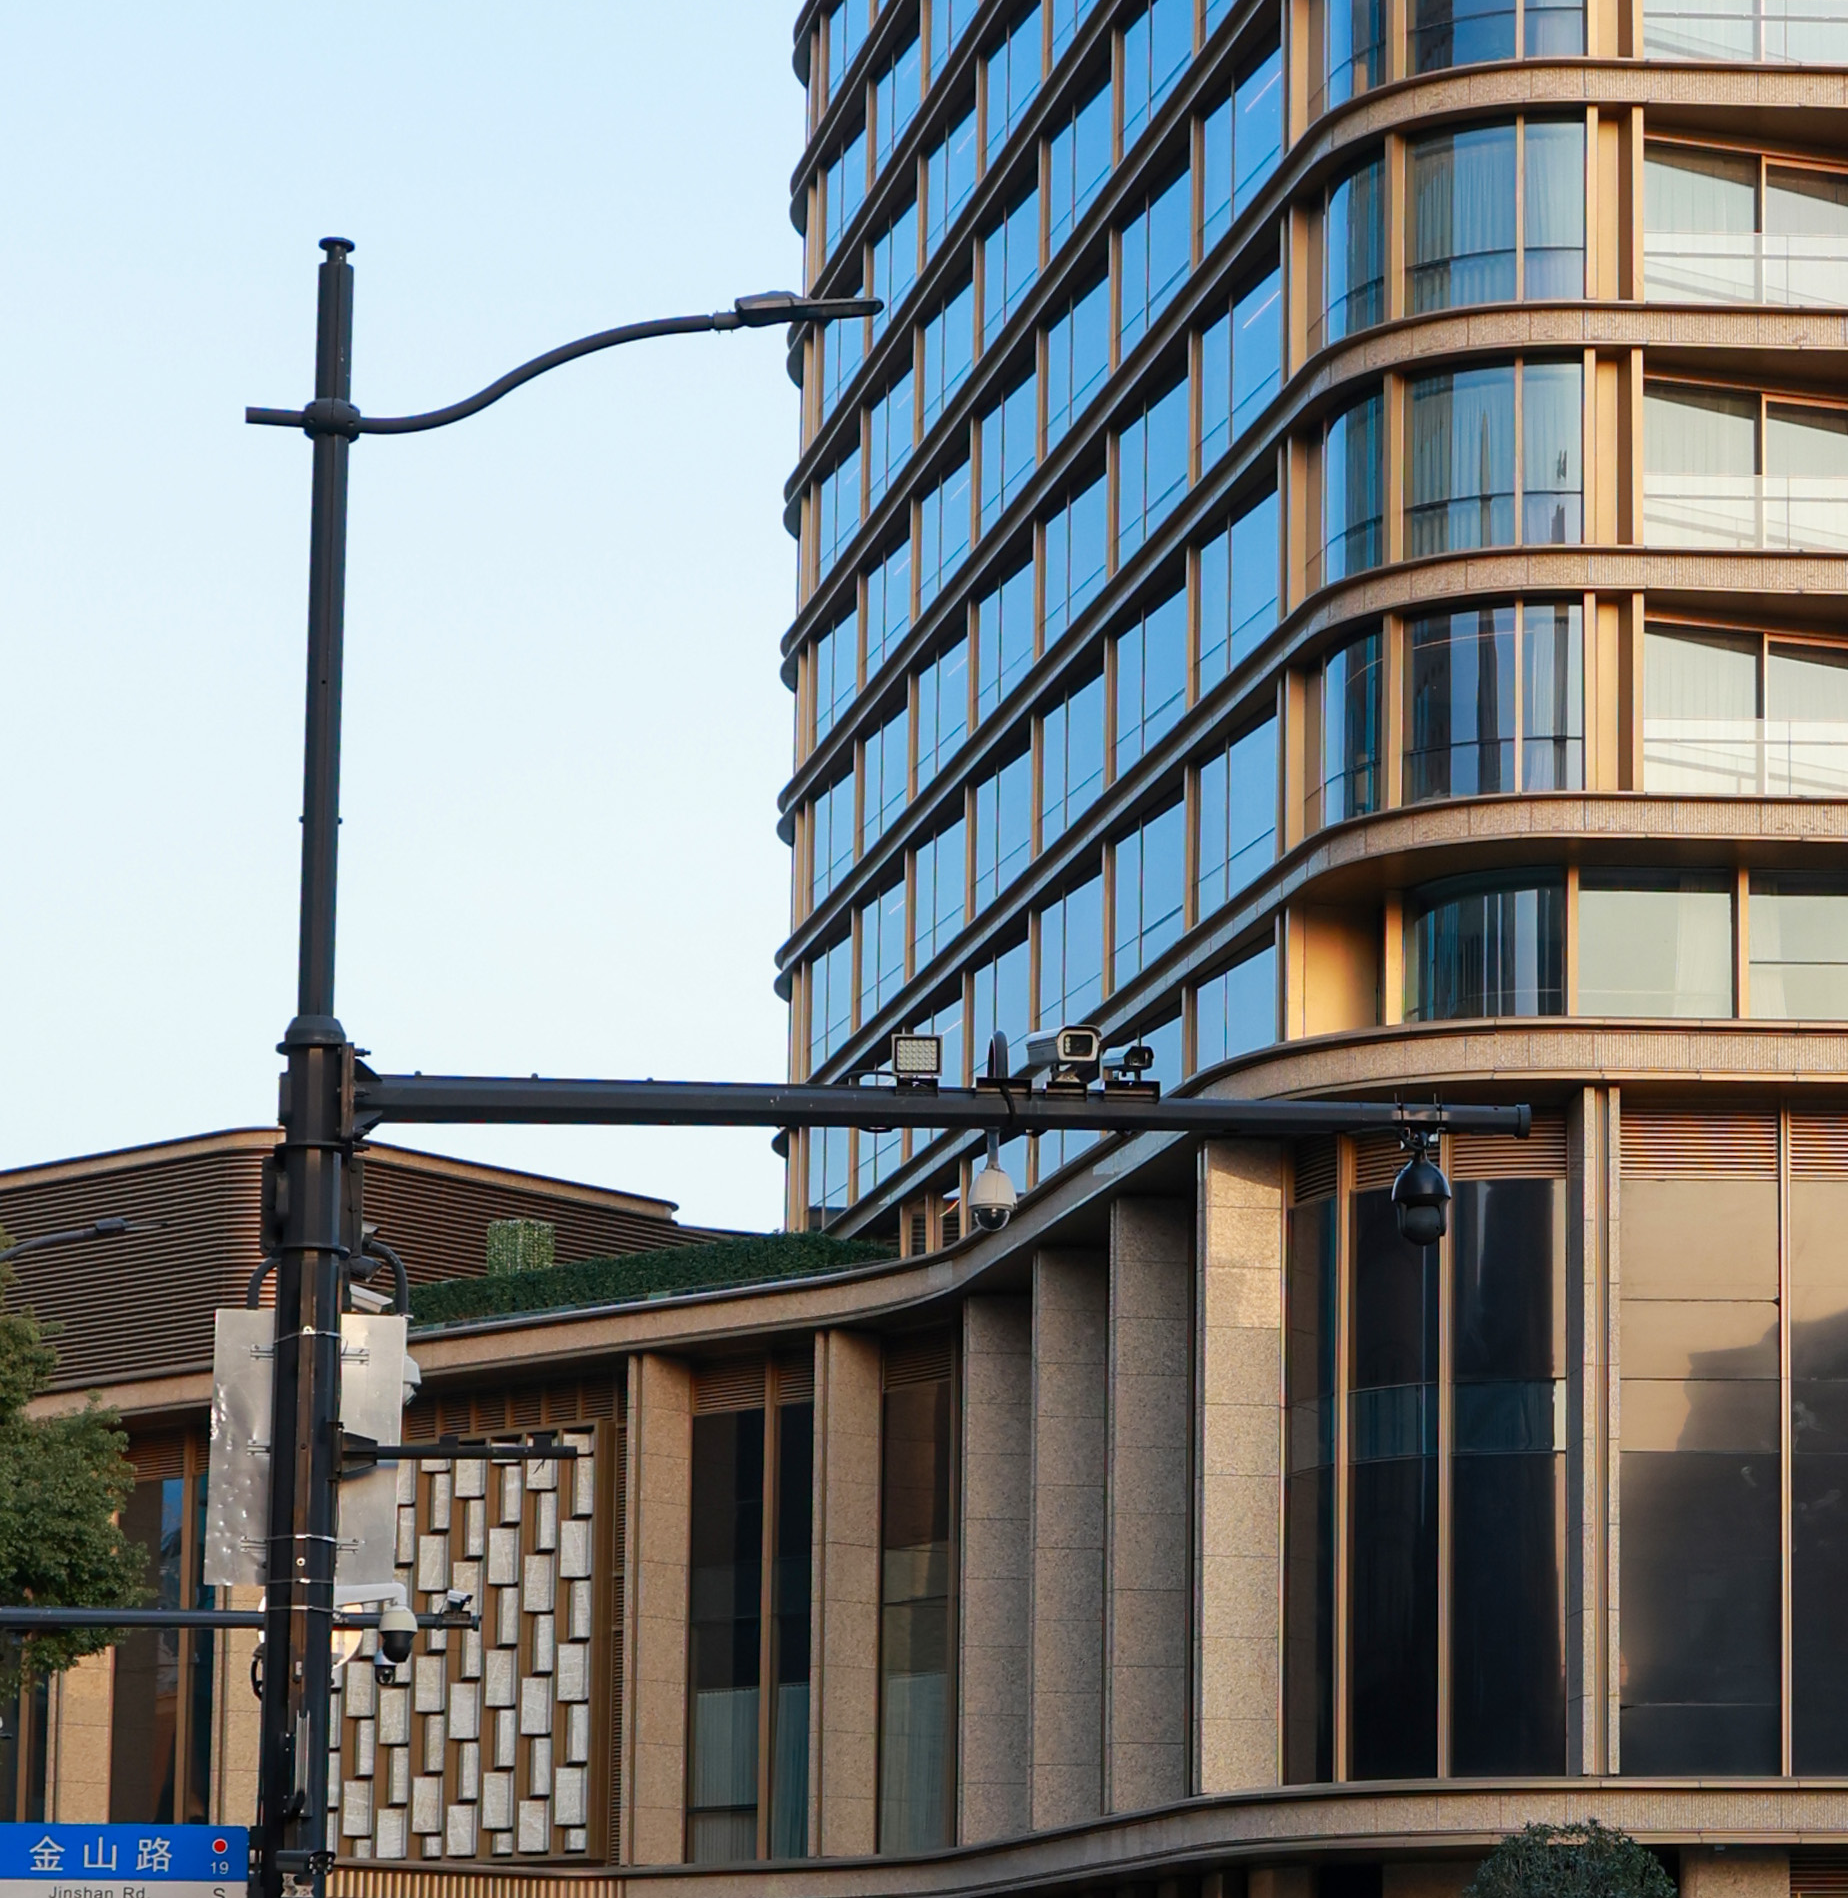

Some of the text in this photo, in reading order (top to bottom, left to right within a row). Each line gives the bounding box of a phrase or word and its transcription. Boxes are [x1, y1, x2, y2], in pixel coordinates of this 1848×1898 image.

[29, 1835, 173, 1873] 金山路
[210, 1861, 229, 1875] 19
